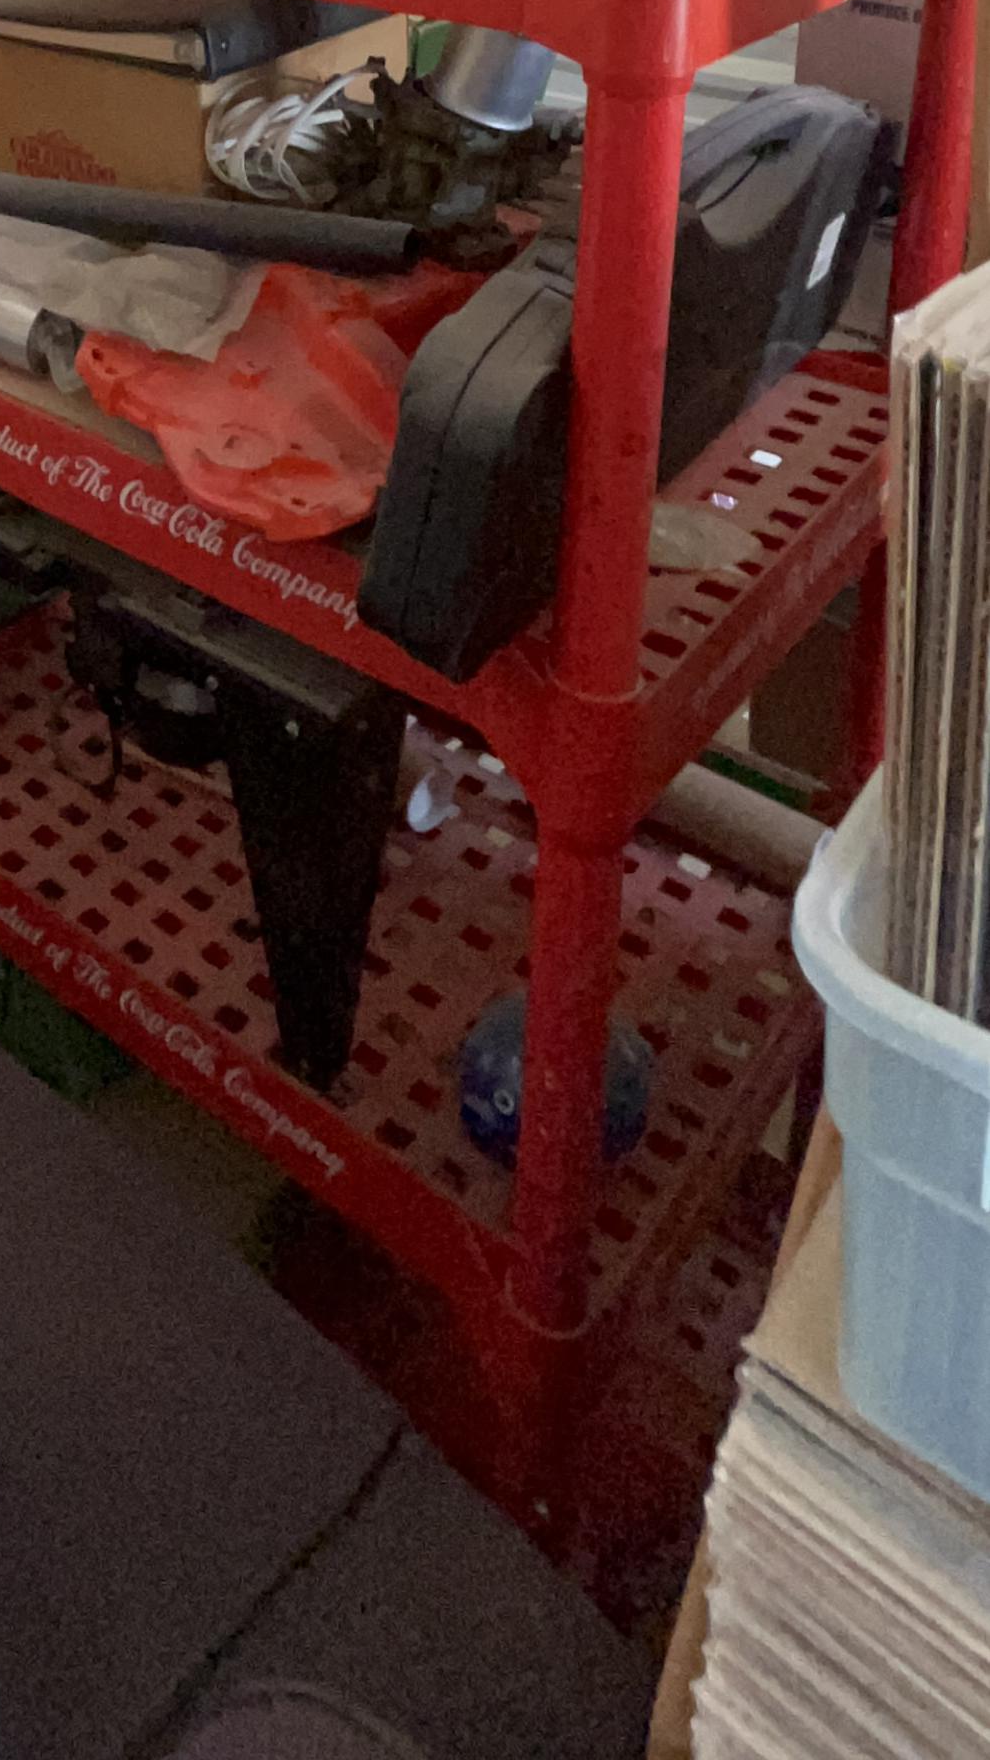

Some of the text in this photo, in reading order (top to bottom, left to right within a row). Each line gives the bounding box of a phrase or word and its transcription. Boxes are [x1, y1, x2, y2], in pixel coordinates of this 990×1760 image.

[40, 456, 66, 486] of
[68, 454, 114, 504] The
[231, 532, 362, 632] Company
[72, 952, 112, 1001] The
[223, 1066, 346, 1180] Company
